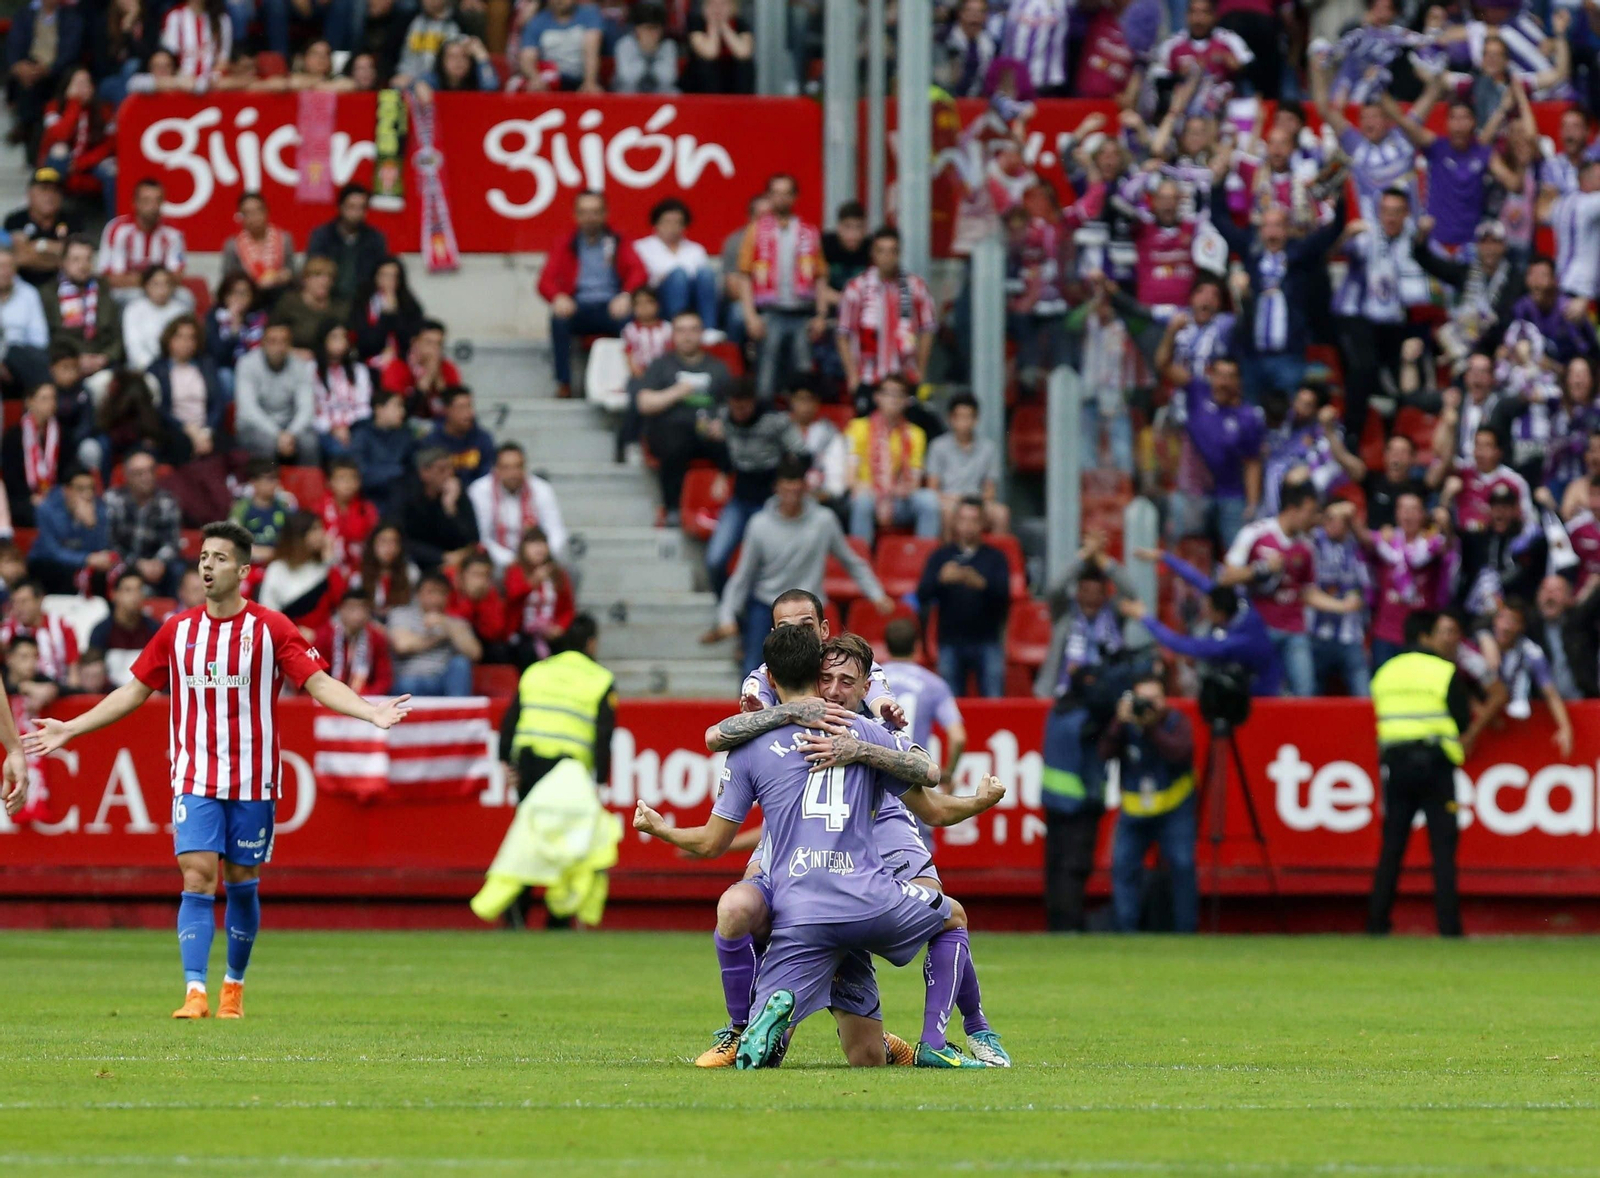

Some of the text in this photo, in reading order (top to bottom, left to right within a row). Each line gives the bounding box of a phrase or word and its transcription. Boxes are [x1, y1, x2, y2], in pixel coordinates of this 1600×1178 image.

[483, 103, 736, 220] gijón
[802, 757, 850, 831] 4
[810, 849, 855, 868] INTEGRA
